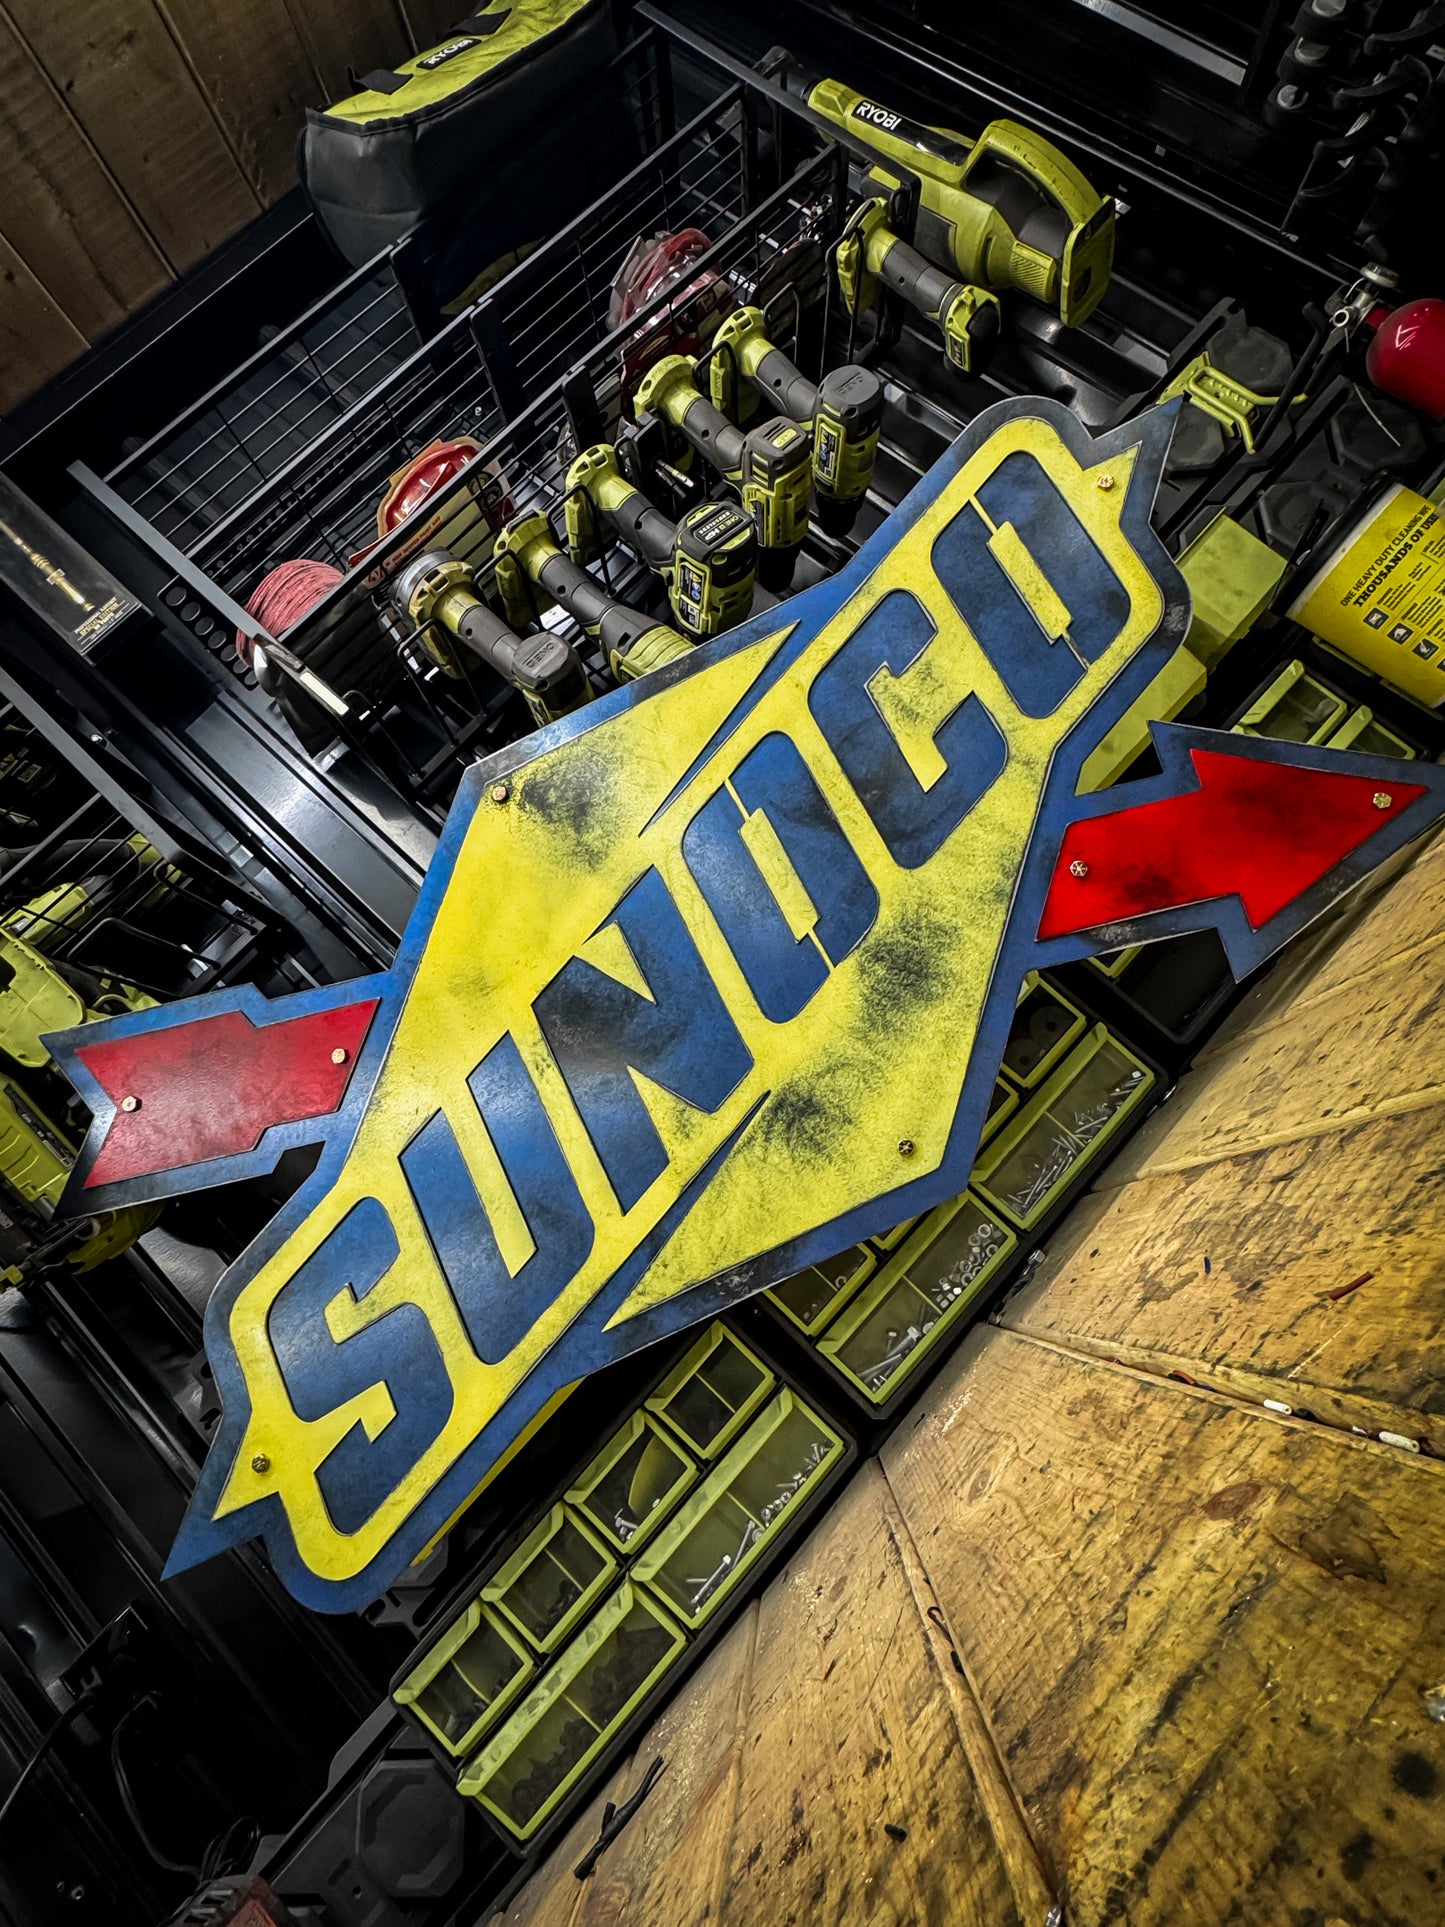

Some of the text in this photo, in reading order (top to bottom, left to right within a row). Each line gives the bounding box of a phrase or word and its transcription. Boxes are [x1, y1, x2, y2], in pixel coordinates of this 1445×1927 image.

[856, 102, 902, 131] RYOBI
[1340, 593, 1357, 607] ONE
[1354, 567, 1378, 592] HEAVY
[1374, 544, 1395, 566] DUTY
[1391, 514, 1423, 546] CLEANING
[1352, 541, 1414, 608] THOUSANDS
[1410, 528, 1425, 543] OF
[267, 449, 1133, 1537] SUNOCO
